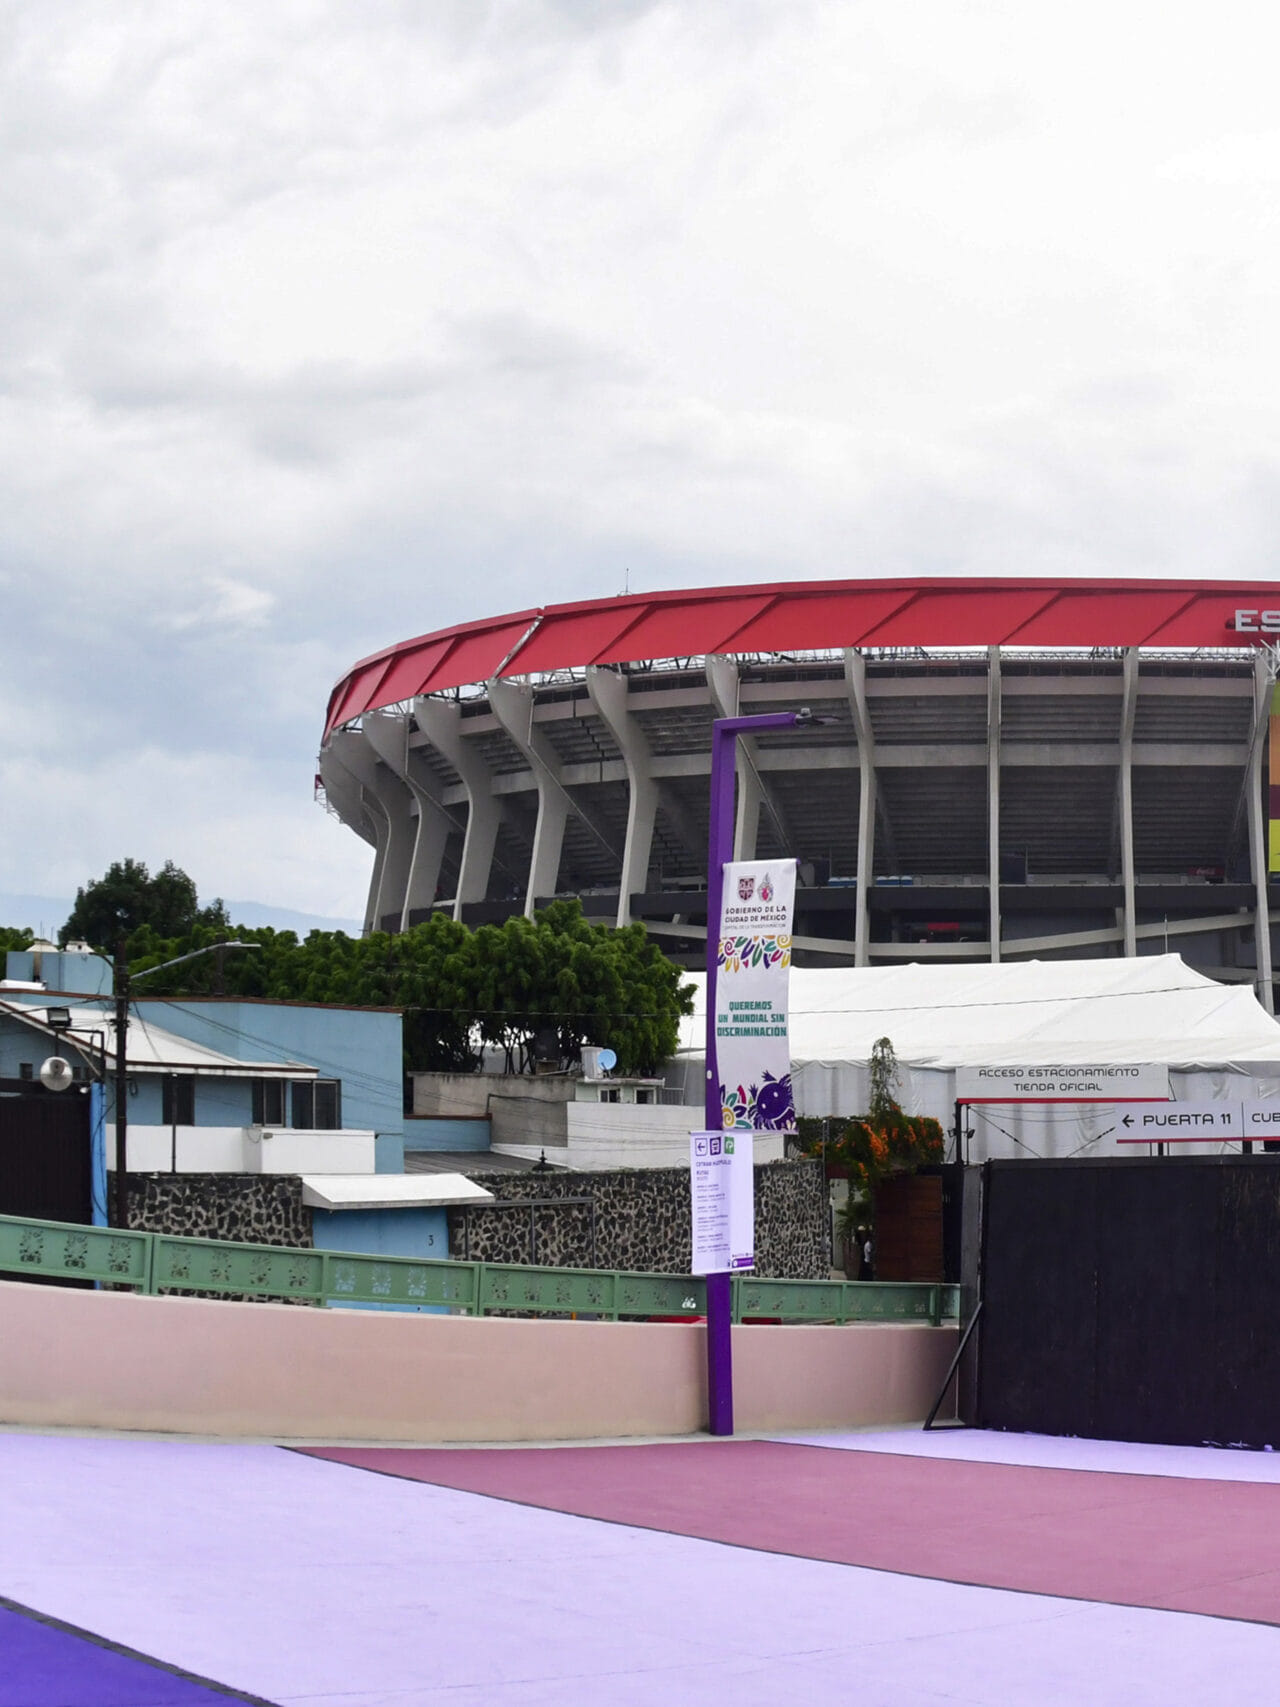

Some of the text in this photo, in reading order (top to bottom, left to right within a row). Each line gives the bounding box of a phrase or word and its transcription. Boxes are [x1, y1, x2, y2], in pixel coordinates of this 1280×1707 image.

[725, 906, 762, 915] GOBIERNO
[764, 905, 775, 913] DE
[729, 1001, 772, 1011] QUEREMOS
[718, 1013, 785, 1023] UN MUNDIAL SIN
[717, 1025, 787, 1037] DISCRIMINACIÓN
[979, 1068, 1140, 1077] ACCESO ESTACIONAMIENTO
[1013, 1082, 1103, 1091] TIENDA OFICIAL
[1143, 1113, 1214, 1126] PUERTA
[1220, 1113, 1231, 1124] 11
